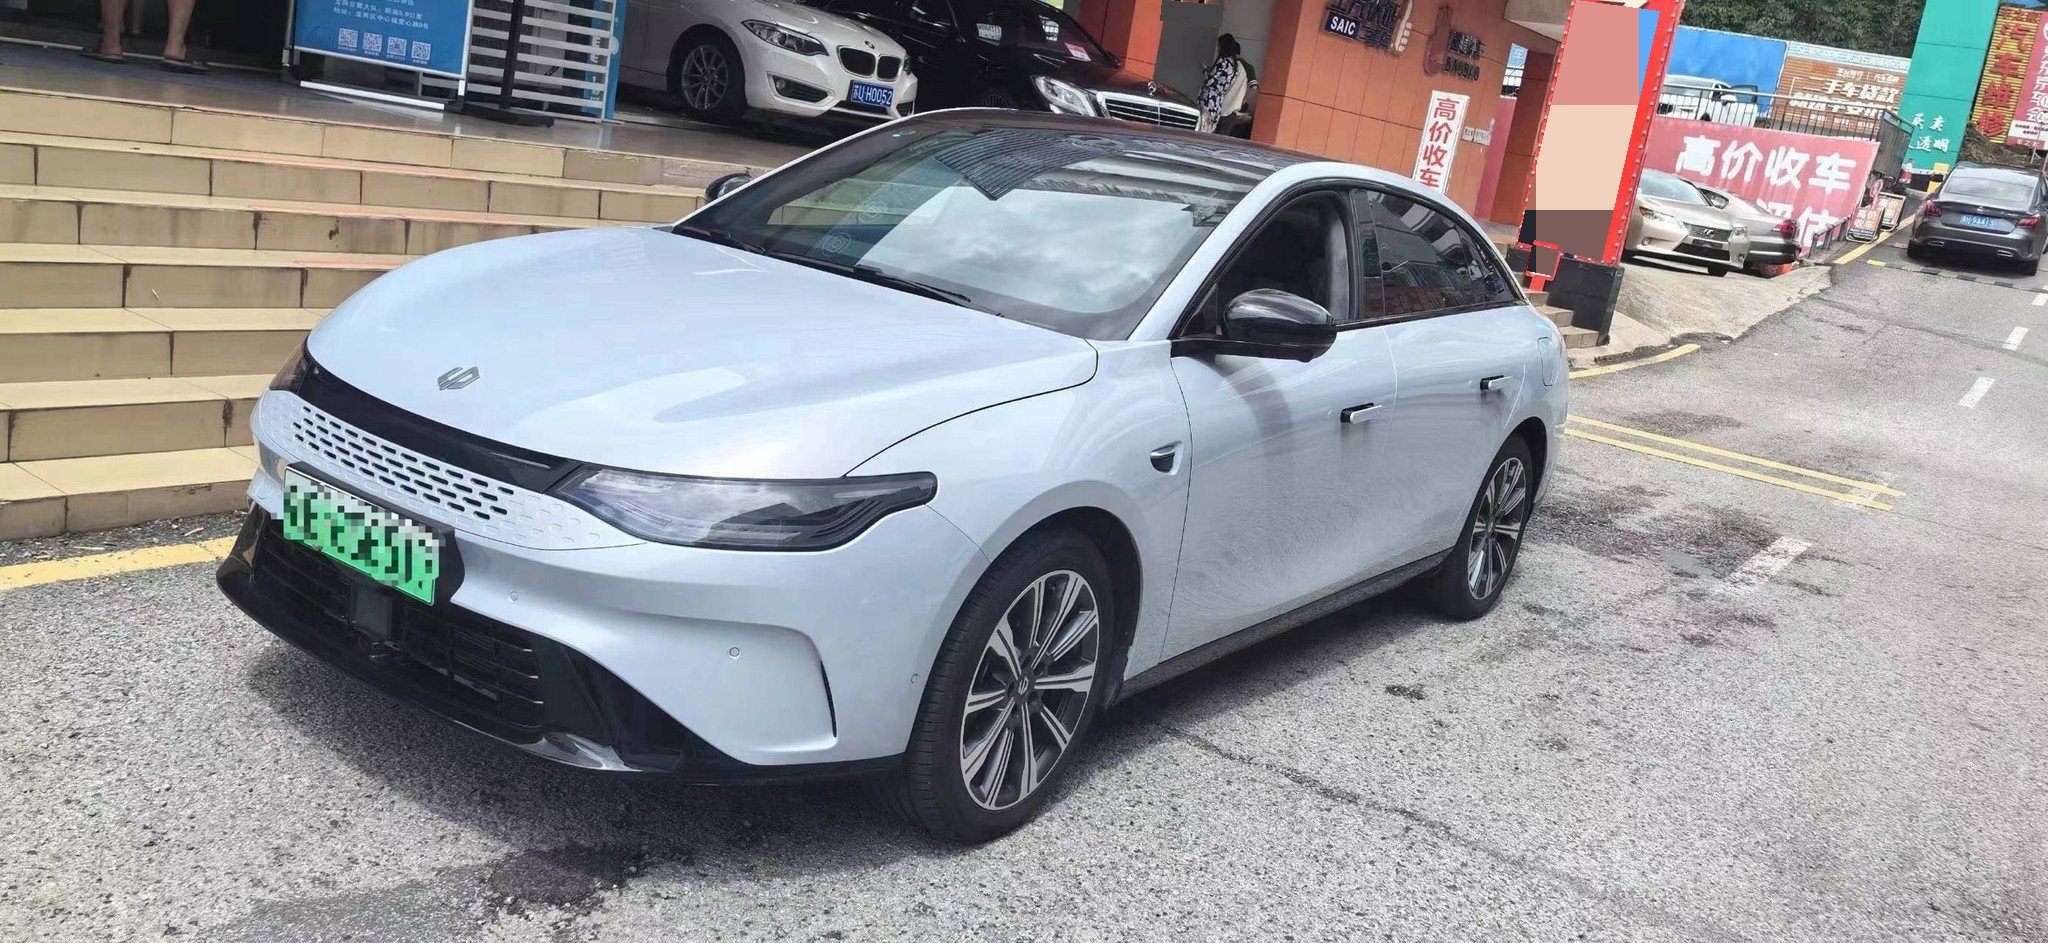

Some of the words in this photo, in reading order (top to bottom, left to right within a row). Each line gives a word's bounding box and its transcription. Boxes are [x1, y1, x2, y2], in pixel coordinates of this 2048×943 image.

[1330, 16, 1356, 36] SAIC
[1976, 23, 2031, 137] 汽车维修
[1419, 98, 1460, 188] 高价收车
[1675, 135, 1856, 195] 高价收车
[1908, 135, 1949, 153] 透明
